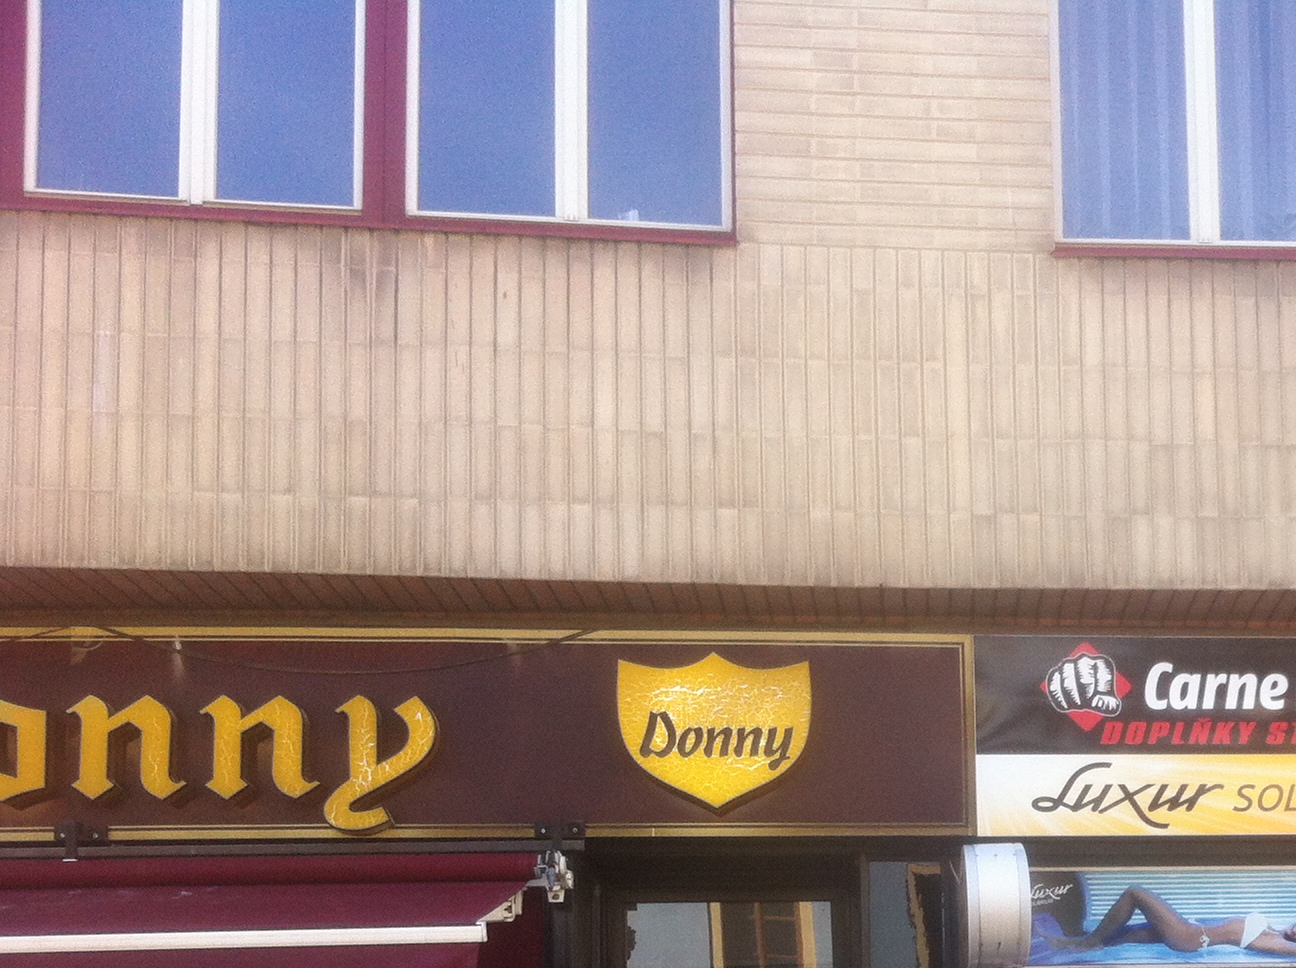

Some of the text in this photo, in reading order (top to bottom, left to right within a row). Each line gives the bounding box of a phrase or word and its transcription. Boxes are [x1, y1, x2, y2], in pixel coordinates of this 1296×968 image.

[1144, 661, 1288, 712] Carne
[639, 710, 794, 771] Donny
[1101, 716, 1257, 746] DOPLŇKY
[1031, 762, 1225, 828] Luxur
